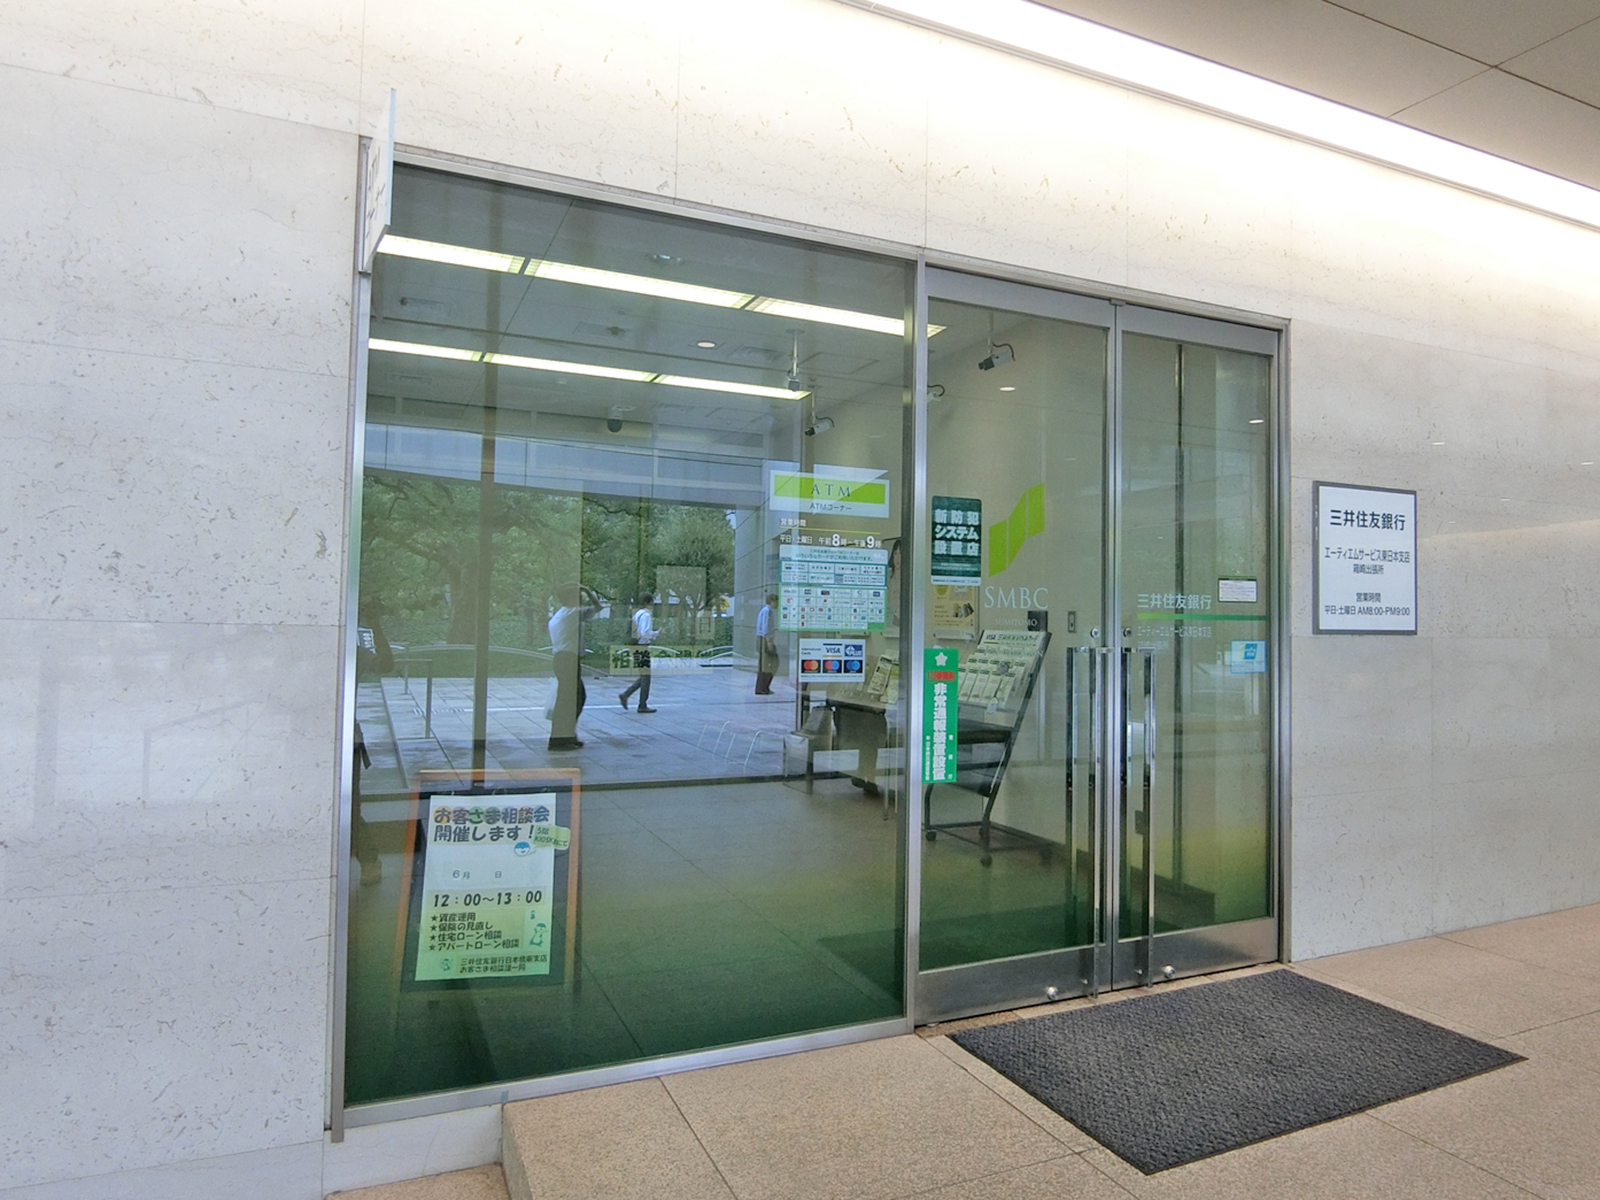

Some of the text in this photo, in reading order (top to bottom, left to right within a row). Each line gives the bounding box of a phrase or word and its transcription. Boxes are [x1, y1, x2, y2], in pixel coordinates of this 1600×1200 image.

[810, 483, 851, 498] ATM
[809, 502, 852, 513] ATMコーナー
[934, 508, 980, 526] 新防犯
[1329, 509, 1406, 532] 三井住友銀行
[934, 524, 979, 540] システム
[934, 540, 980, 556] 設置店
[984, 586, 1049, 610] SMBC
[1137, 593, 1212, 610] 三井住友銀行
[433, 805, 550, 825] お客さま相談会
